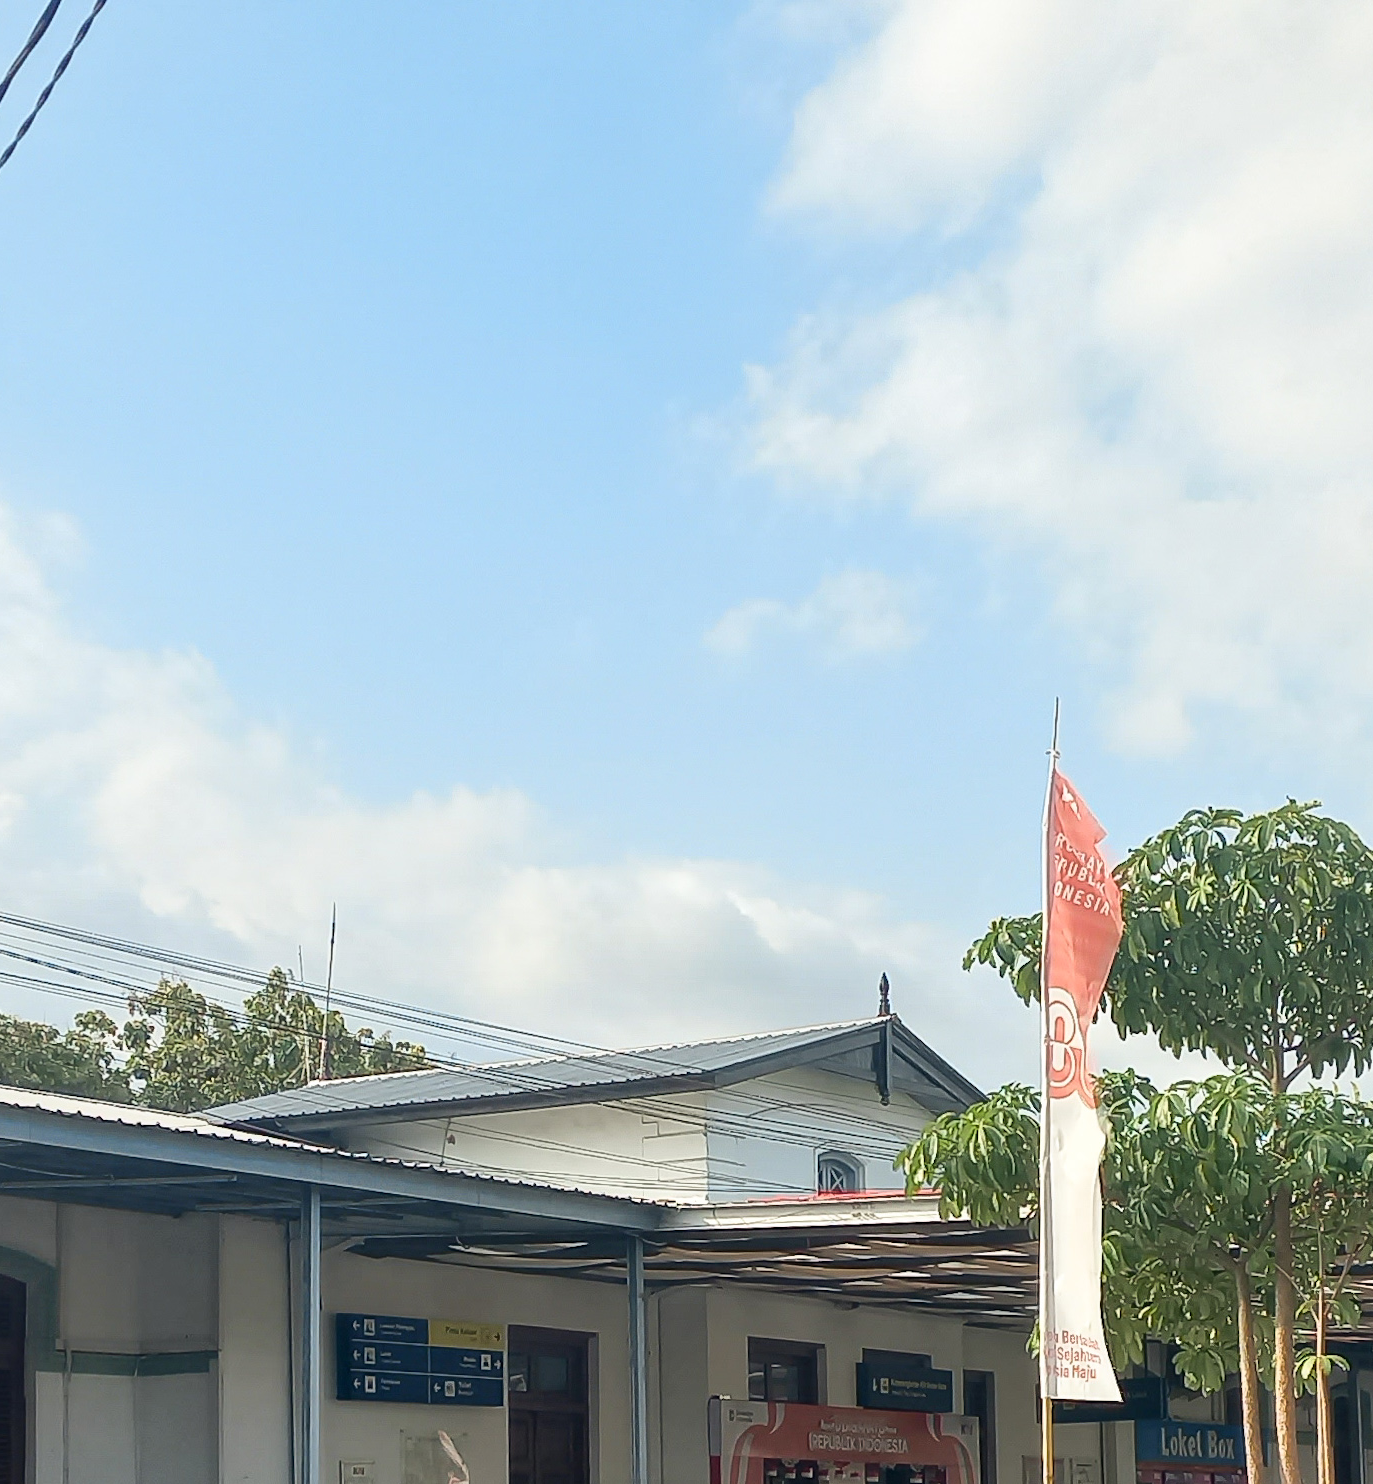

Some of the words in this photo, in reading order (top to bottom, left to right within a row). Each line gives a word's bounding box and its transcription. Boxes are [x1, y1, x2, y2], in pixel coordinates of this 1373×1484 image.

[811, 1432, 857, 1452] REPUBLIK
[1160, 1427, 1203, 1458] Loket
[1207, 1430, 1235, 1460] Box
